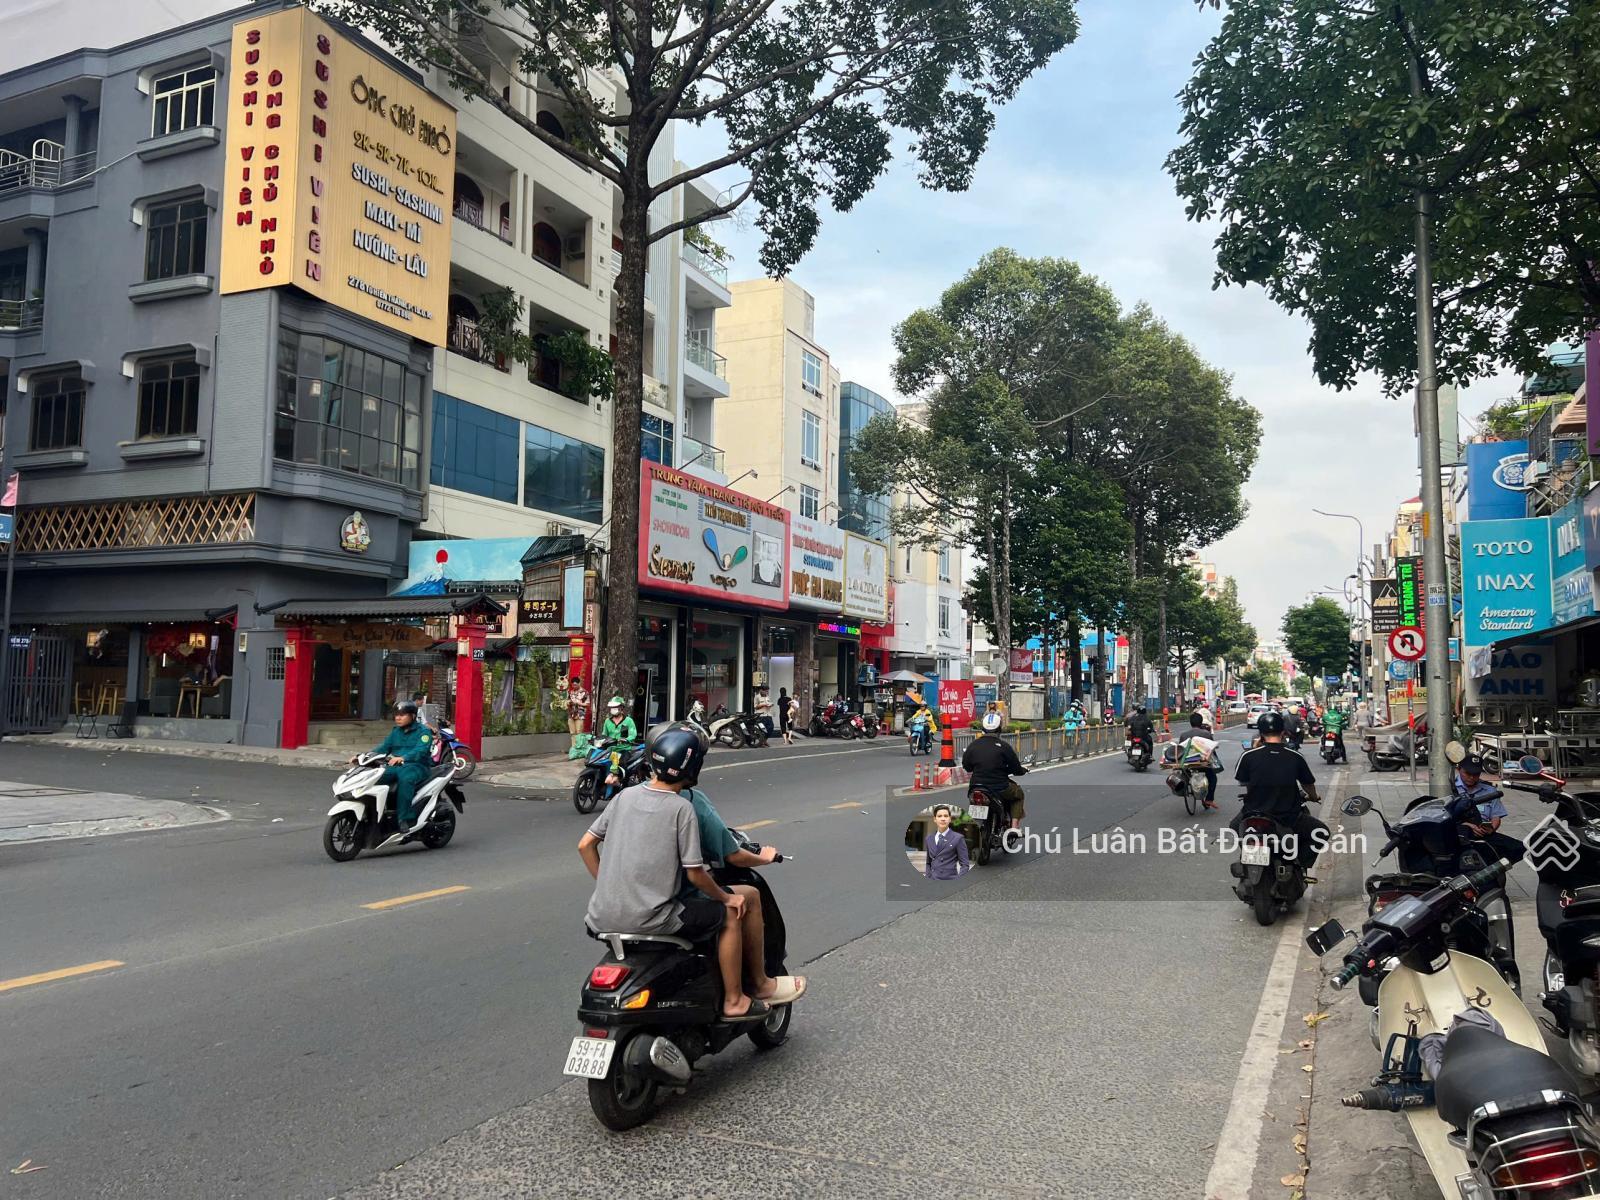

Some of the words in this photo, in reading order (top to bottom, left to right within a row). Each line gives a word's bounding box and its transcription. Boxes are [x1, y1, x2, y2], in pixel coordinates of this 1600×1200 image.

[243, 29, 260, 127] SUSHI
[237, 145, 255, 226] VIÊN
[263, 144, 280, 202] CHỦ
[260, 217, 277, 275] NHỎ
[353, 229, 397, 264] NƯỚNG
[649, 467, 684, 487] TRUNG
[707, 487, 736, 505] TRANG
[1473, 540, 1534, 556] TOTO
[1477, 573, 1536, 592] INAX
[1402, 580, 1415, 612] TRANG
[1480, 606, 1537, 618] American
[1480, 618, 1534, 631] Standard
[1478, 678, 1545, 696] ANH
[576, 1040, 608, 1058] 59-FA
[568, 1057, 606, 1075] 038.88
